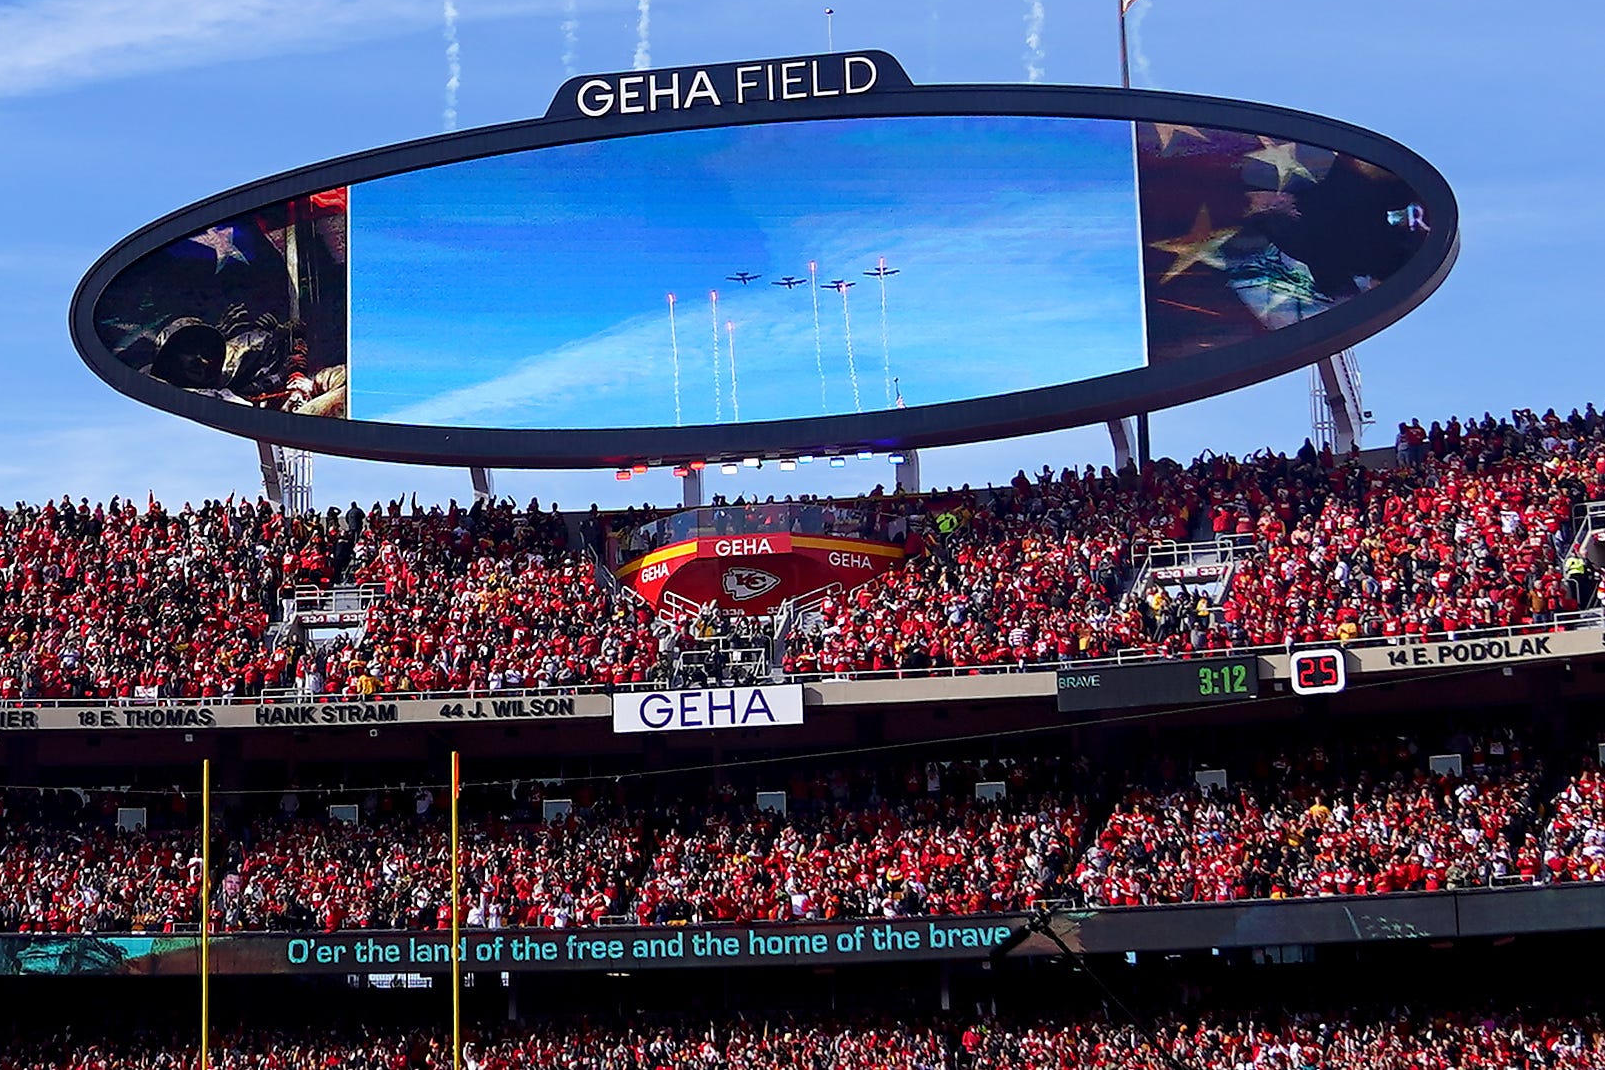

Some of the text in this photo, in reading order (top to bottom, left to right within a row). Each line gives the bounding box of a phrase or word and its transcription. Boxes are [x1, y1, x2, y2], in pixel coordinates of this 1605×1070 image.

[576, 57, 877, 118] GEHA FIELD
[715, 539, 773, 556] GEHA
[828, 551, 873, 570] GEHA
[641, 562, 669, 583] GEHA
[1388, 636, 1551, 667] 14 E. PODOLAK
[1058, 674, 1100, 689] BRAVE
[1198, 664, 1247, 695] 3:12
[1300, 656, 1337, 687] 25
[78, 708, 214, 727] 18 E. THOMAS
[256, 704, 397, 725] HANK STRAM
[439, 698, 574, 718] 44 J. WILSON
[640, 689, 776, 728] GEHA
[354, 938, 400, 963] the
[409, 937, 467, 962] land
[476, 937, 504, 962] of
[510, 936, 558, 961] the
[566, 935, 624, 960] free
[632, 933, 684, 958] and
[692, 931, 740, 956] the
[748, 930, 828, 955] home
[836, 926, 867, 952] of
[871, 924, 921, 950] the
[929, 922, 1012, 948] brave
